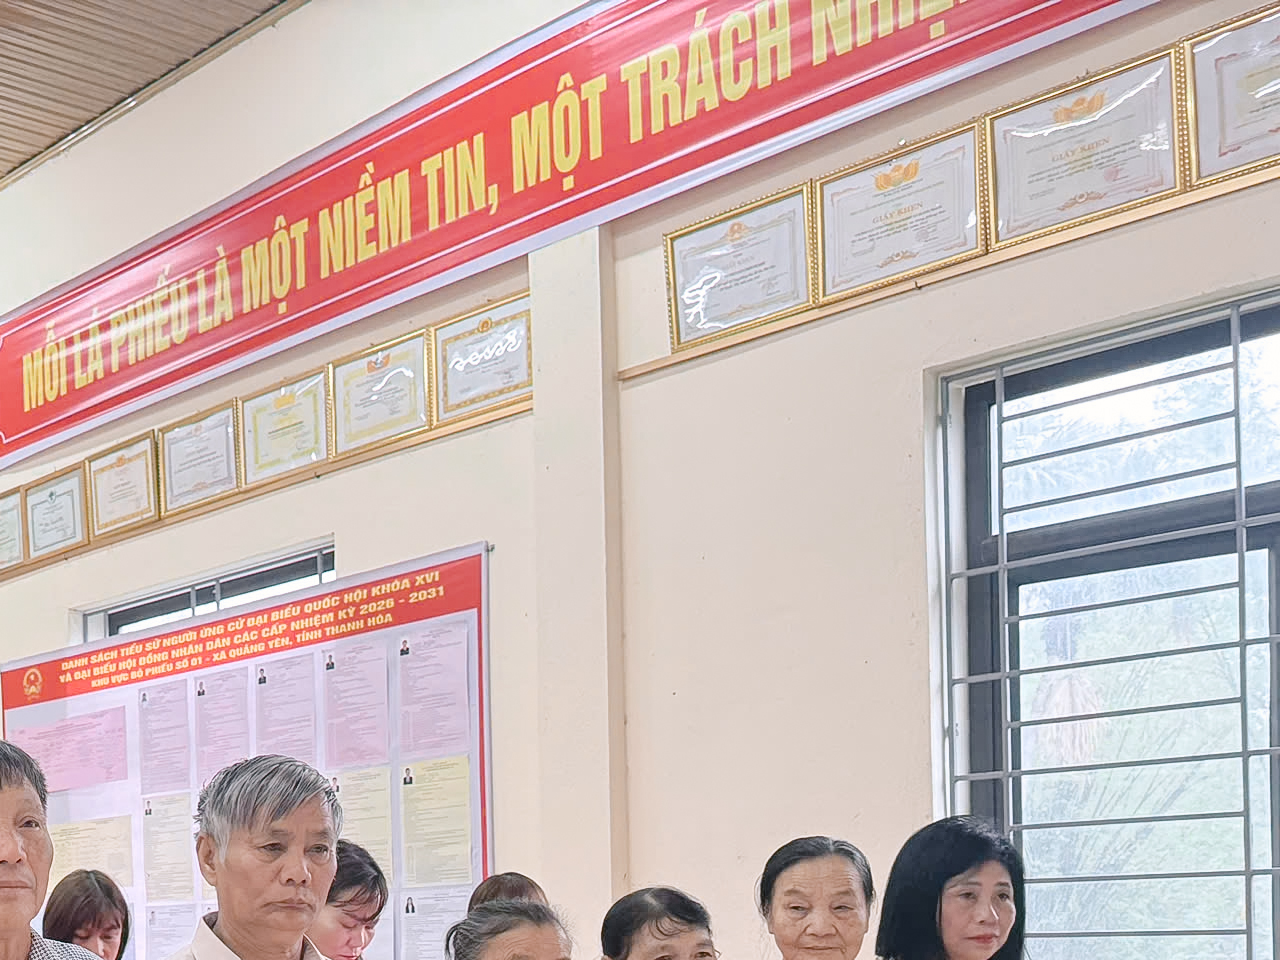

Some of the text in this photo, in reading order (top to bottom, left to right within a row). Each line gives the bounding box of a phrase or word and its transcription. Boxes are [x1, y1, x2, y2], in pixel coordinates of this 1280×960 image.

[74, 307, 104, 389] LÁ
[110, 265, 189, 373] PHIẾU
[196, 246, 233, 334] LÀ
[241, 215, 309, 314] MỘT
[319, 161, 412, 280] NIỀM
[421, 132, 498, 232] TIN,
[510, 72, 608, 193] MỘT
[620, 0, 791, 144] TRÁCH
[61, 657, 88, 671] DANH
[90, 650, 118, 664] SÁCH
[246, 614, 268, 627] ĐẠI
[304, 595, 340, 613] QUỐC
[343, 588, 368, 603] HỘI
[371, 578, 410, 597] KHÓA
[415, 571, 440, 586] XVI
[91, 677, 109, 688] KHU
[175, 657, 189, 670] SỐ
[191, 656, 202, 666] 01
[229, 642, 265, 658] QUẢNG
[325, 618, 364, 636] THANH
[367, 613, 393, 627] HÓA
[118, 658, 136, 670] HỘI
[171, 643, 203, 659] NHÂN
[206, 637, 231, 651] DÂN
[234, 630, 259, 644] CÁC
[261, 622, 287, 638] CẤP
[291, 612, 334, 631] NHIỆM
[360, 598, 395, 615] 2026
[409, 586, 445, 603] 2031
